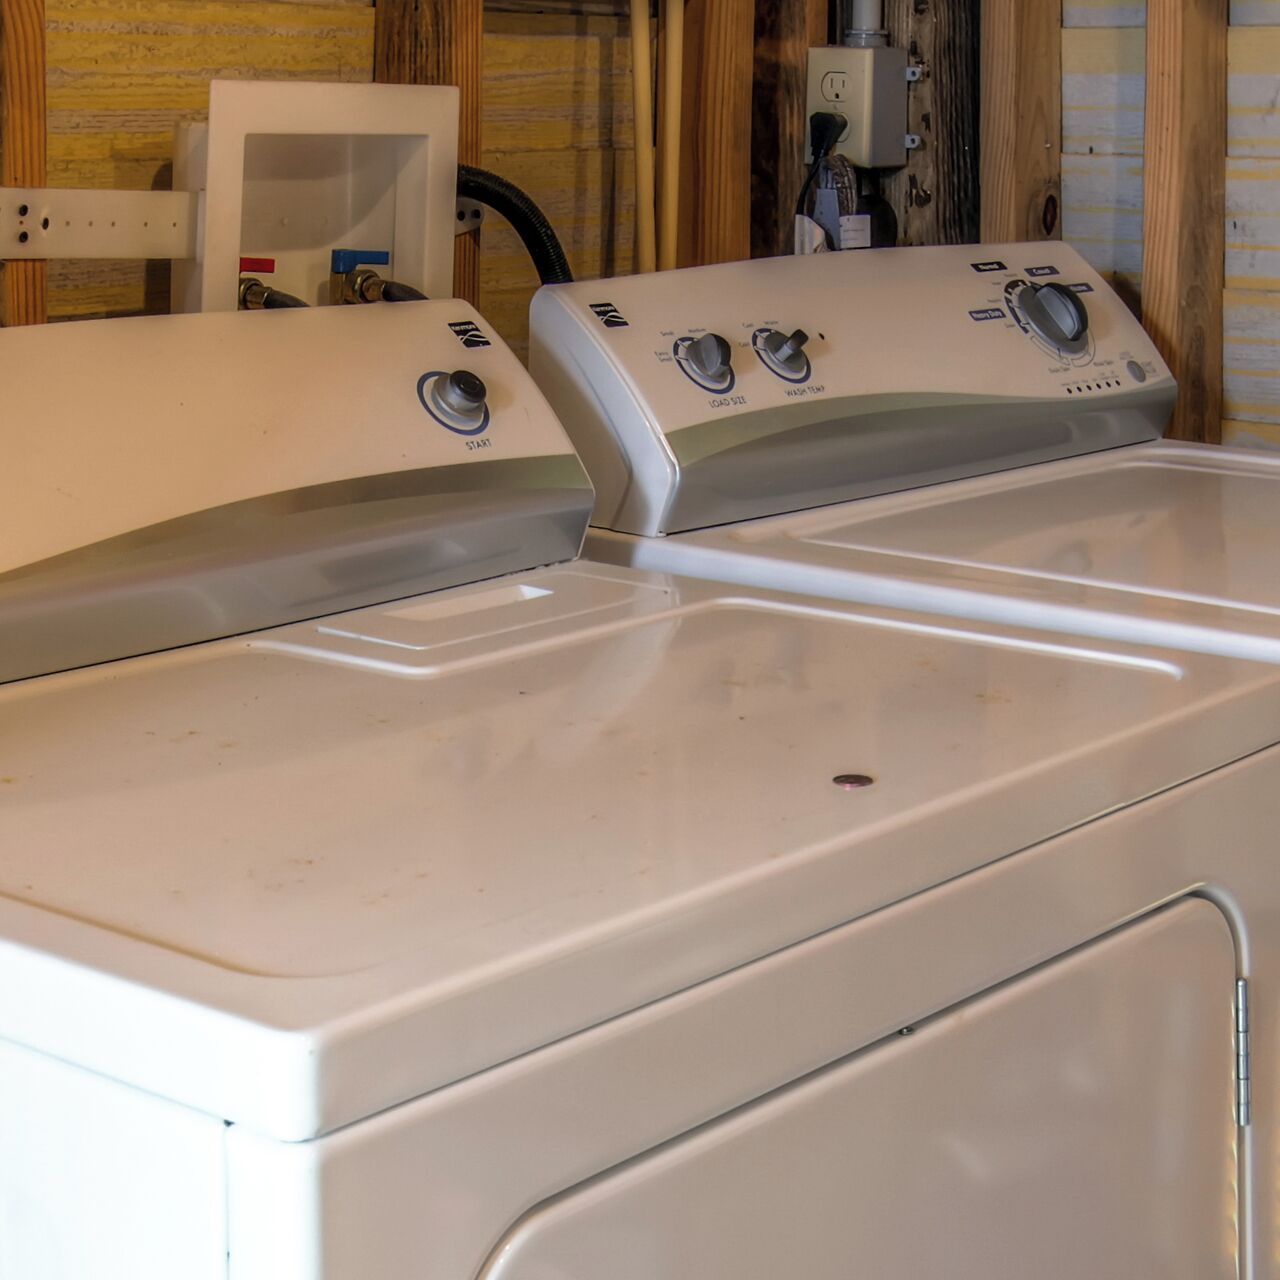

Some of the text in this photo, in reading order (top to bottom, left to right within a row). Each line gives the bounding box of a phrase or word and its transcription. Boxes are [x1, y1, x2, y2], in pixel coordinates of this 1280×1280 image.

[784, 385, 826, 397] WASH TEMP
[708, 396, 747, 408] LOAD SIZE
[466, 438, 492, 451] START
